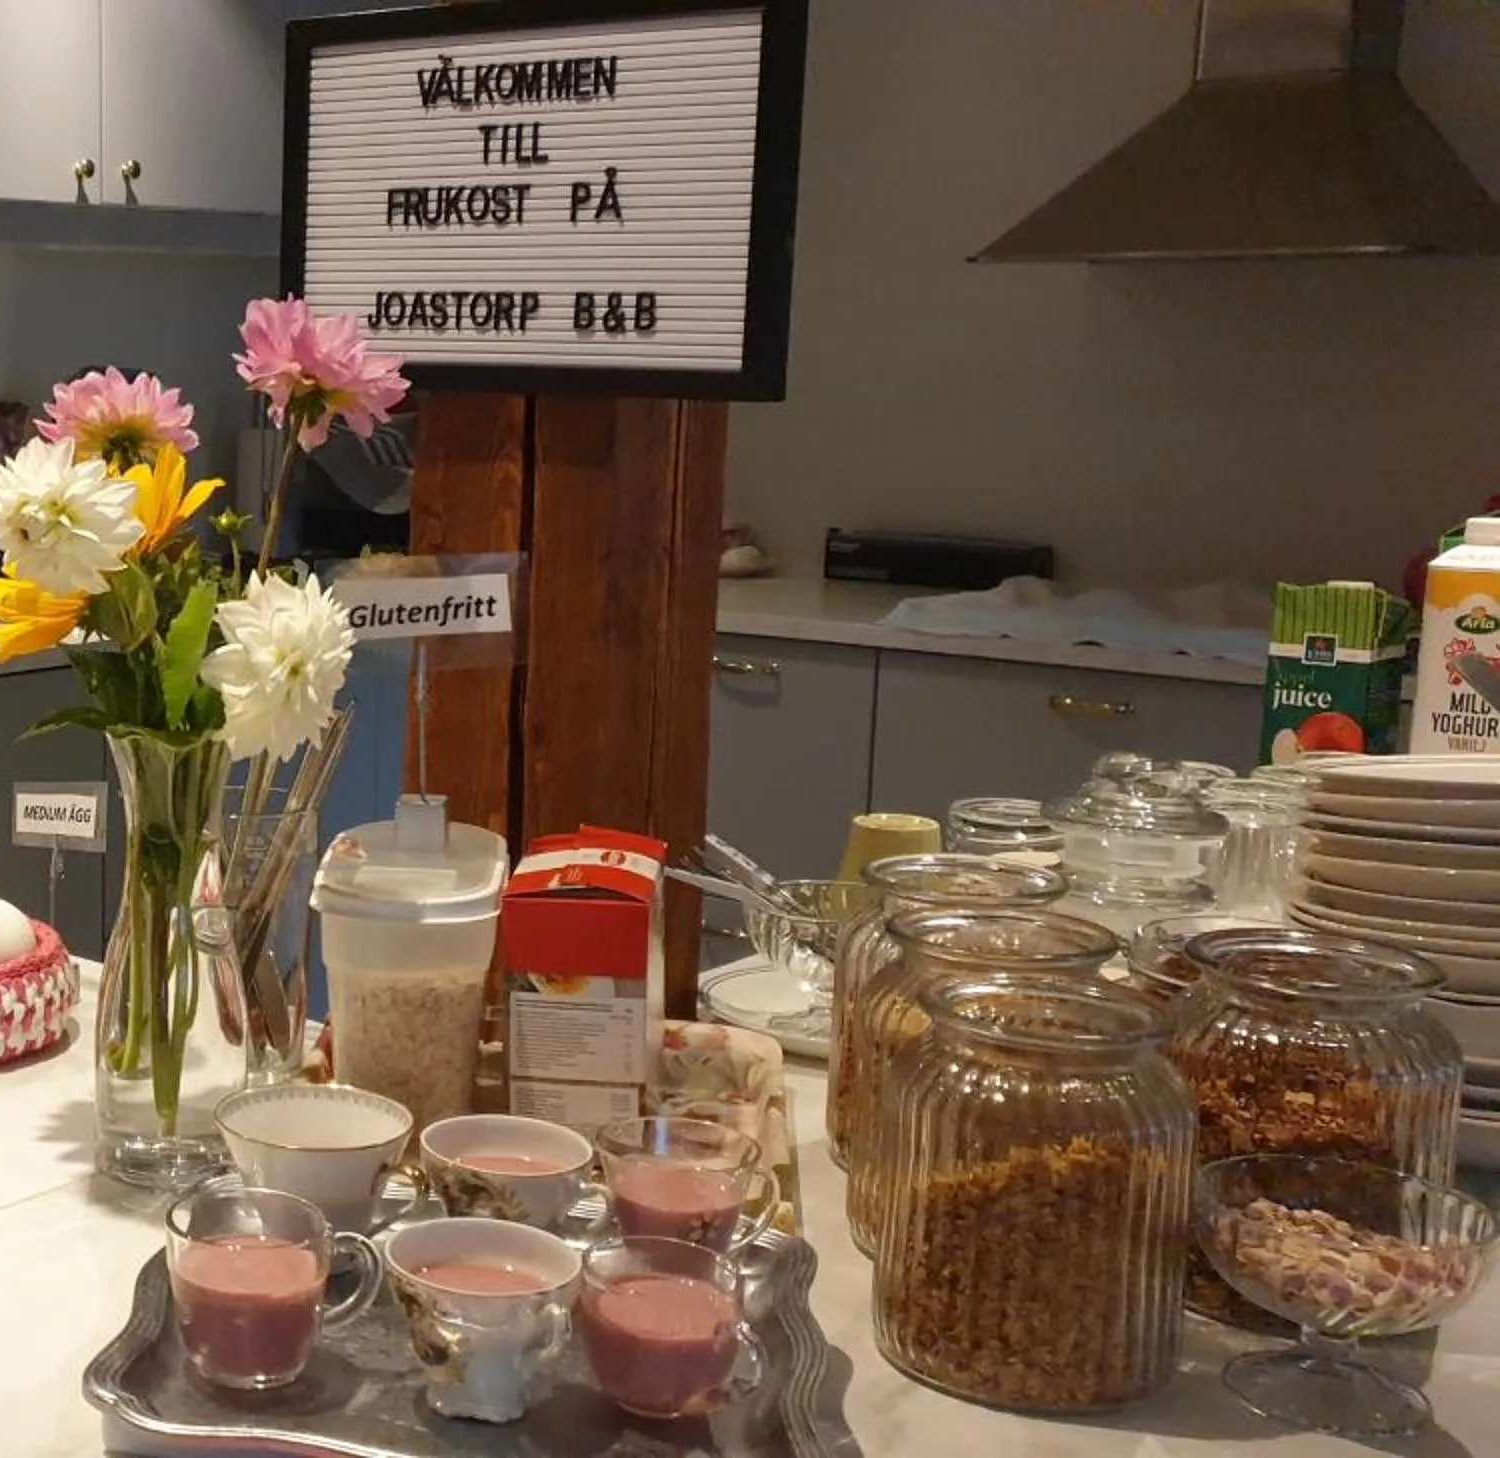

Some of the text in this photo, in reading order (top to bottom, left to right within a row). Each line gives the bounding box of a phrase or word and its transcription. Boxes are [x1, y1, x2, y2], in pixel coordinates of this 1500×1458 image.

[417, 55, 618, 107] VÄLKOMMEN
[479, 122, 549, 165] TILL
[387, 167, 623, 227] FRUKOST PÅ
[368, 291, 657, 333] JOASTORP B&B
[350, 595, 497, 628] Glutenfritt
[1461, 617, 1495, 630] Arla
[1272, 681, 1332, 710] juice
[24, 803, 92, 823] MEDIUM ÄGG
